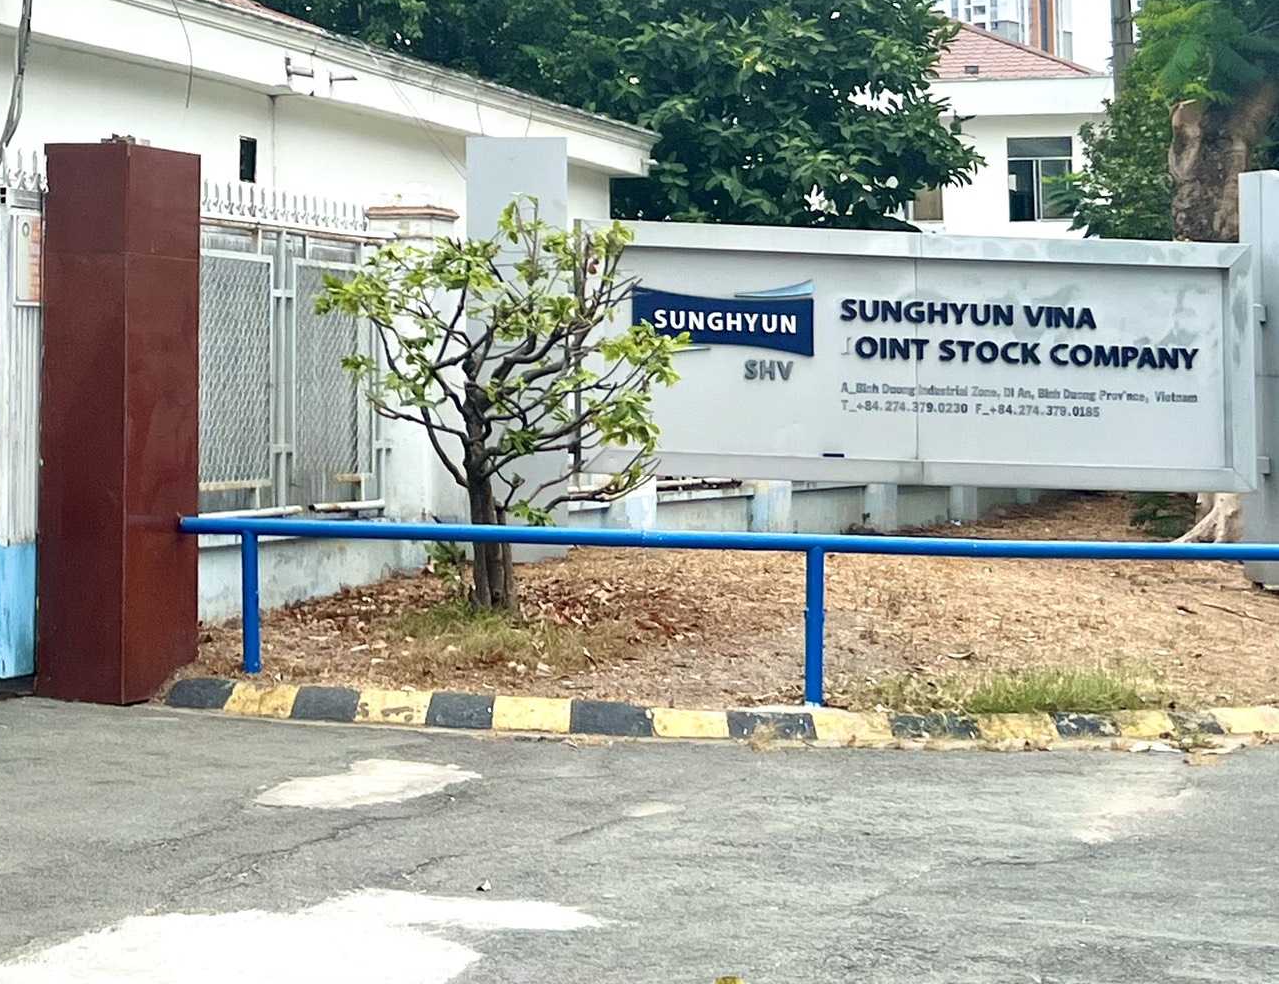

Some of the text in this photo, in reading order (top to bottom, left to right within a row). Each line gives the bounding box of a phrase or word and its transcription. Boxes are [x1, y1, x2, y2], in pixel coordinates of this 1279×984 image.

[654, 309, 797, 334] SUNGHYUN
[840, 298, 1097, 330] SUNGHYUN VINA
[938, 338, 1041, 365] STOCK
[1049, 343, 1199, 370] COMPANY
[744, 359, 794, 381] SHV
[1154, 390, 1198, 403] Vietnam
